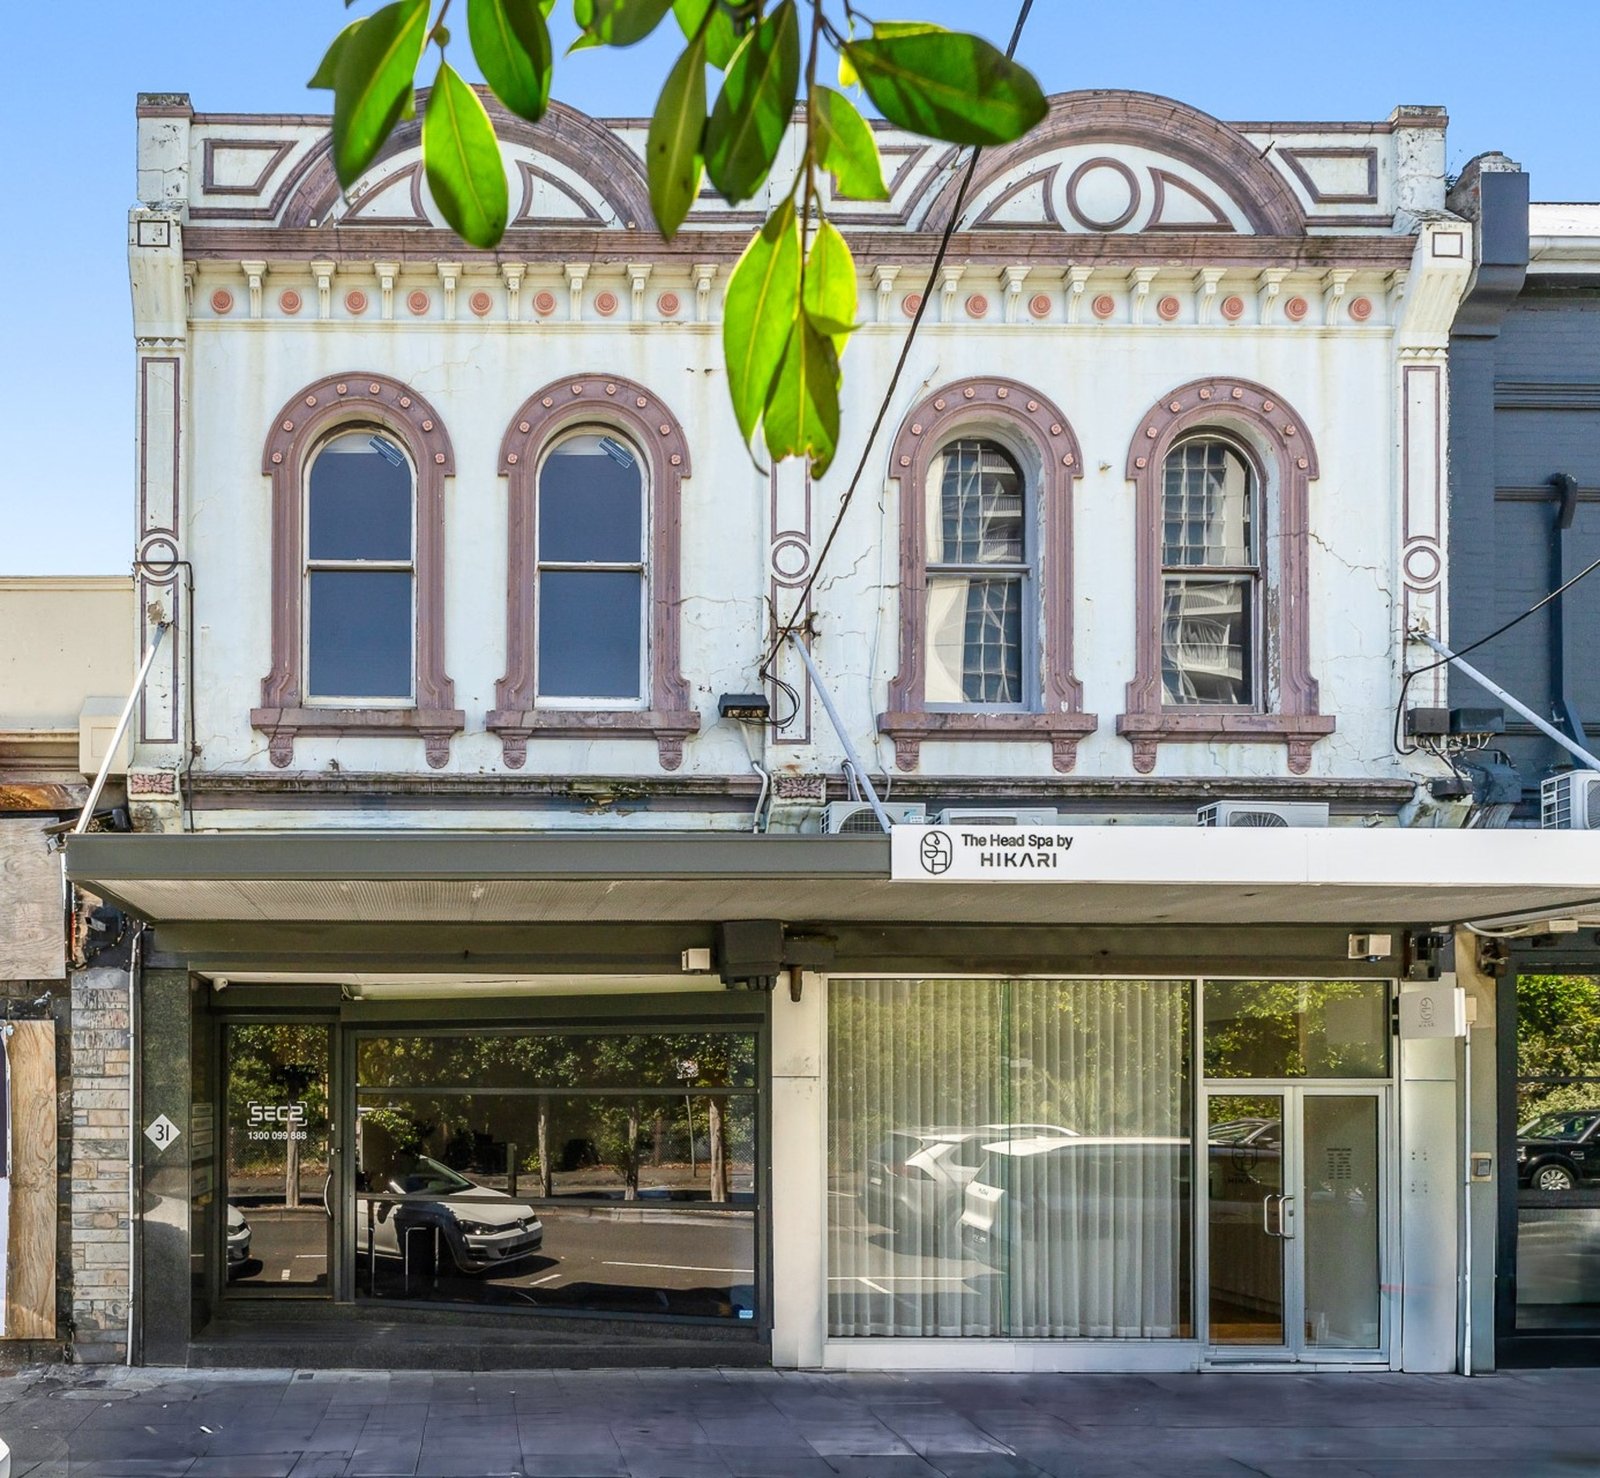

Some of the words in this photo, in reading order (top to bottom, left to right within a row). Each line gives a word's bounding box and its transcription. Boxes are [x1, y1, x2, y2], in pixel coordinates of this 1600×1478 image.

[961, 834, 987, 847] The
[990, 834, 1024, 847] Head
[1028, 834, 1054, 849] Spa
[1057, 834, 1073, 850] by
[981, 852, 1057, 867] HIKARI
[155, 1124, 169, 1141] 31
[248, 1131, 270, 1140] 1300
[271, 1131, 289, 1140] 099
[290, 1131, 307, 1140] 888
